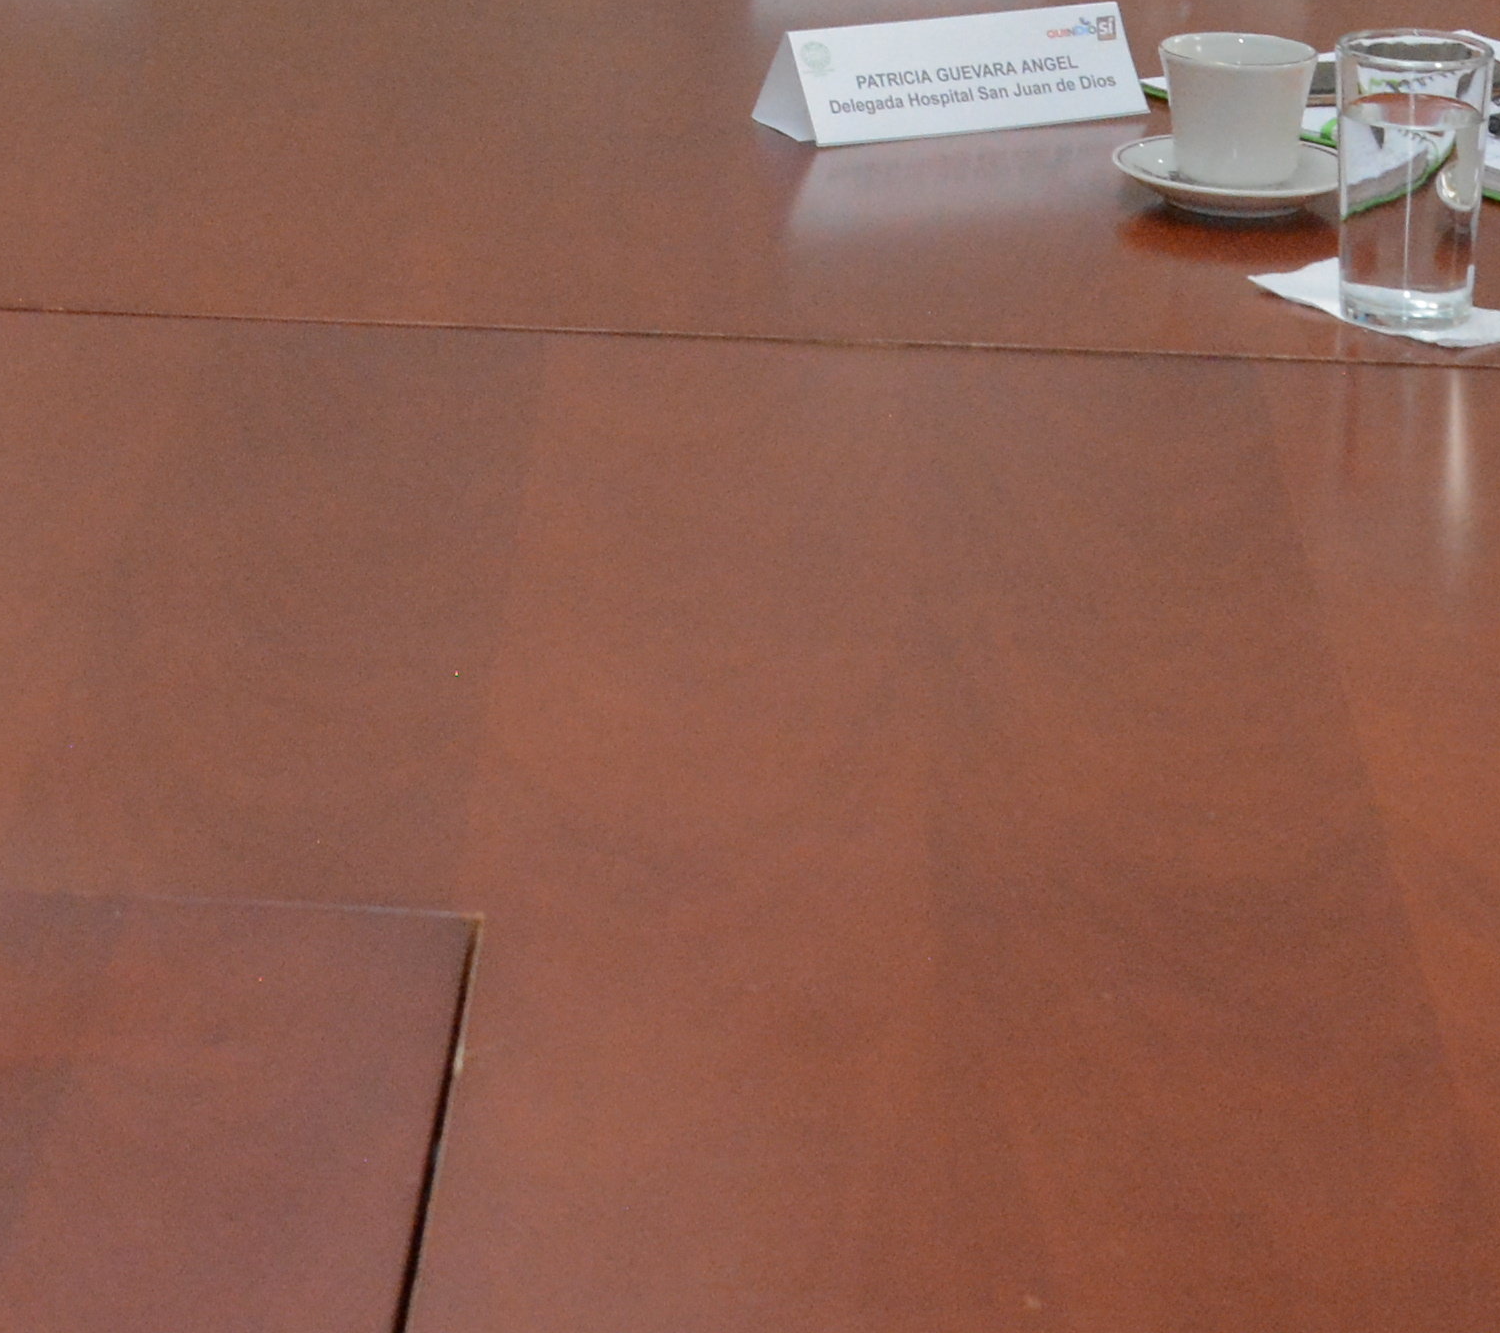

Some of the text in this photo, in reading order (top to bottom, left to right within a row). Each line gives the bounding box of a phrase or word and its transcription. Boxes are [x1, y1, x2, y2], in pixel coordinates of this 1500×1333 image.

[855, 53, 1080, 91] PATRICIA GUEVARA ANGEL
[828, 72, 1117, 118] Delegada Hospital San Juan de Dios
